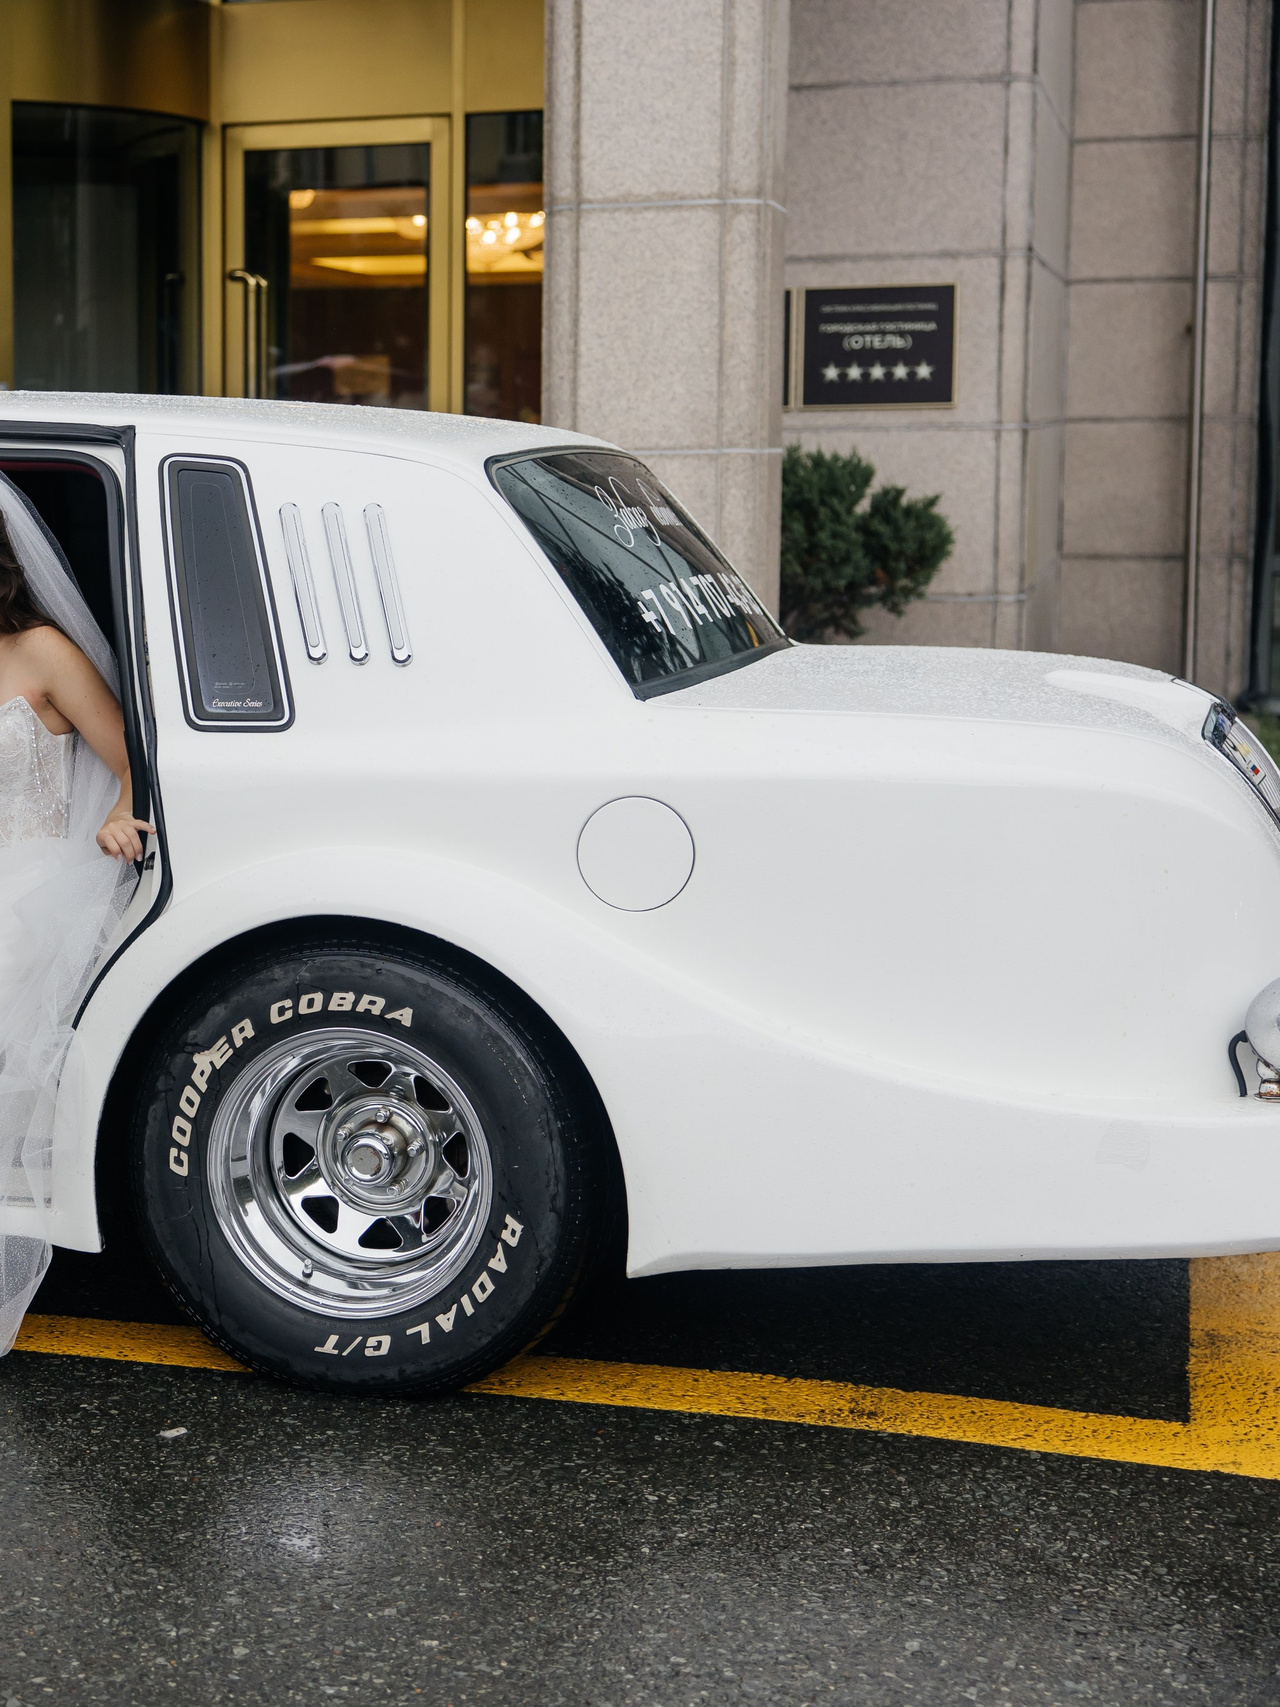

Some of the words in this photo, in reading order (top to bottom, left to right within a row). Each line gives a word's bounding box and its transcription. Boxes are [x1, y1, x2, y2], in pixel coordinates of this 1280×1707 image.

[842, 333, 913, 351] (ОТЕЛЬ)
[637, 588, 676, 636] +7
[212, 698, 242, 707] Executive
[243, 698, 263, 707] Series
[169, 1018, 255, 1177] COOPER
[270, 991, 414, 1028] COBRA
[406, 1213, 524, 1345] RADIAL
[314, 1334, 391, 1357] G/T
